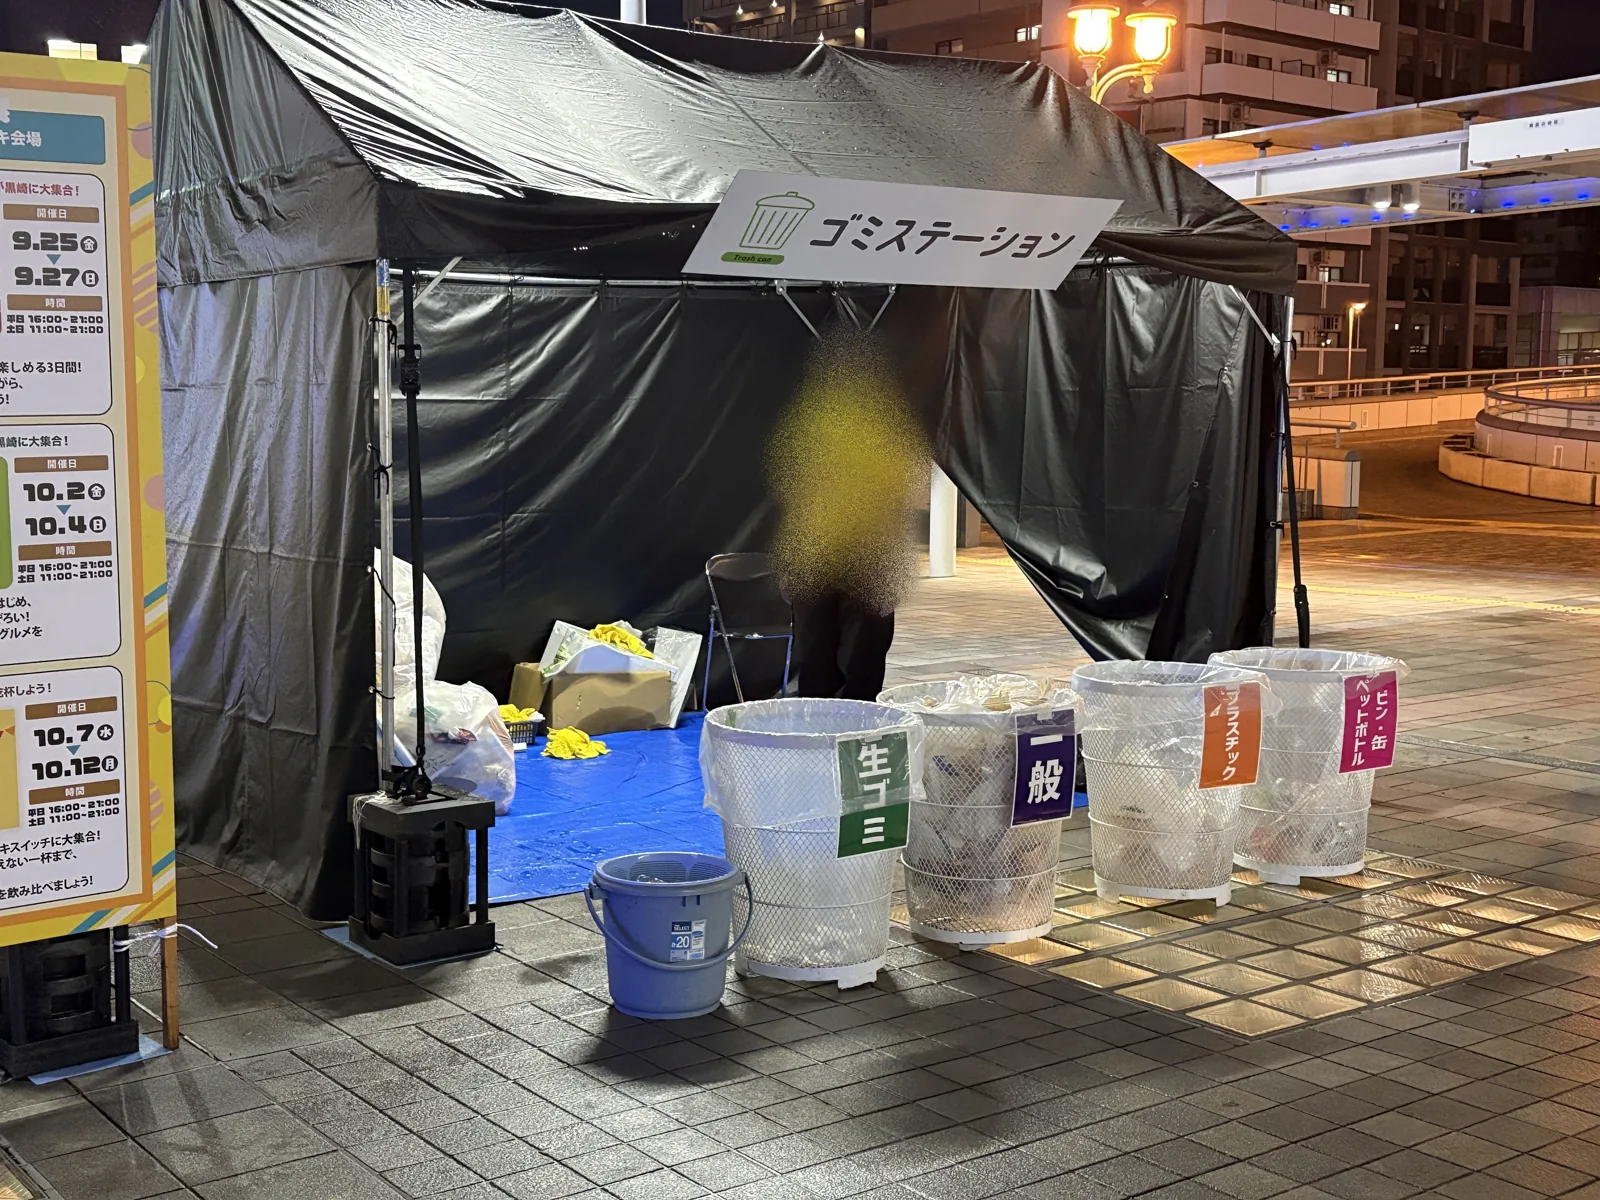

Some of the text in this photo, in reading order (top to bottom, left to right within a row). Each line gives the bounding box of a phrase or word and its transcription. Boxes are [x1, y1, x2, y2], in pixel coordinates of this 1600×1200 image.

[36, 207, 67, 219] 開催日
[810, 213, 1076, 259] ゴミステーション
[734, 254, 756, 262] Trash
[45, 297, 66, 308] 時間
[6, 314, 25, 324] 平日
[6, 324, 25, 334] 土日
[47, 459, 77, 469] 開催日
[55, 545, 76, 556] 時間
[18, 564, 36, 574] 平日
[17, 574, 36, 584] 土日
[0, 611, 30, 625] ろい!
[57, 702, 86, 714] 開催日
[1351, 679, 1371, 767] ペットボトル
[1371, 690, 1389, 751] ビン・缶
[1222, 688, 1240, 781] プラスチック
[1027, 733, 1064, 804] 一般
[65, 786, 85, 797] 時間
[857, 743, 892, 844] 生ゴミ
[28, 807, 46, 818] 平日
[28, 817, 46, 827] 土日
